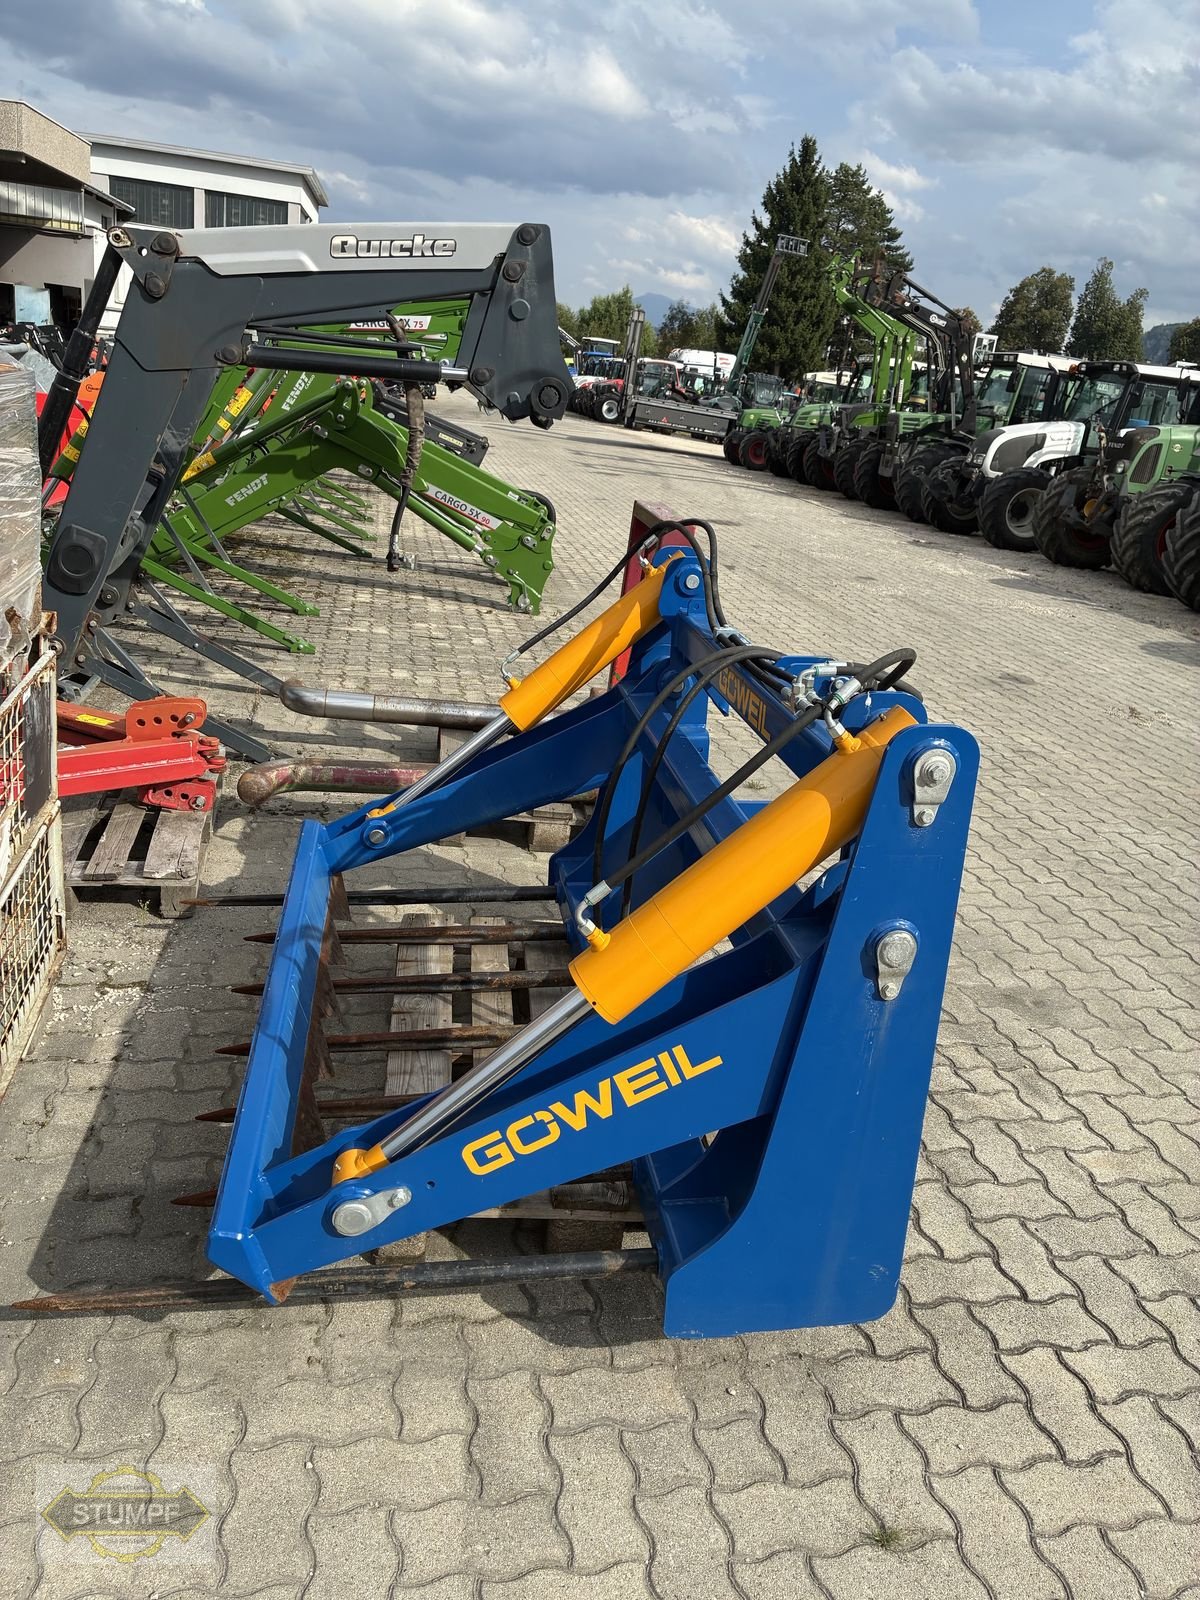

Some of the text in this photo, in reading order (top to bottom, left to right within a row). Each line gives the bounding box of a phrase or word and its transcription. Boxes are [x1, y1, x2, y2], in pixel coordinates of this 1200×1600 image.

[330, 233, 457, 259] Quicke
[413, 320, 424, 329] 75
[281, 371, 309, 411] FENDT
[224, 473, 269, 507] FENDT
[434, 490, 492, 526] CARGO 5X 90
